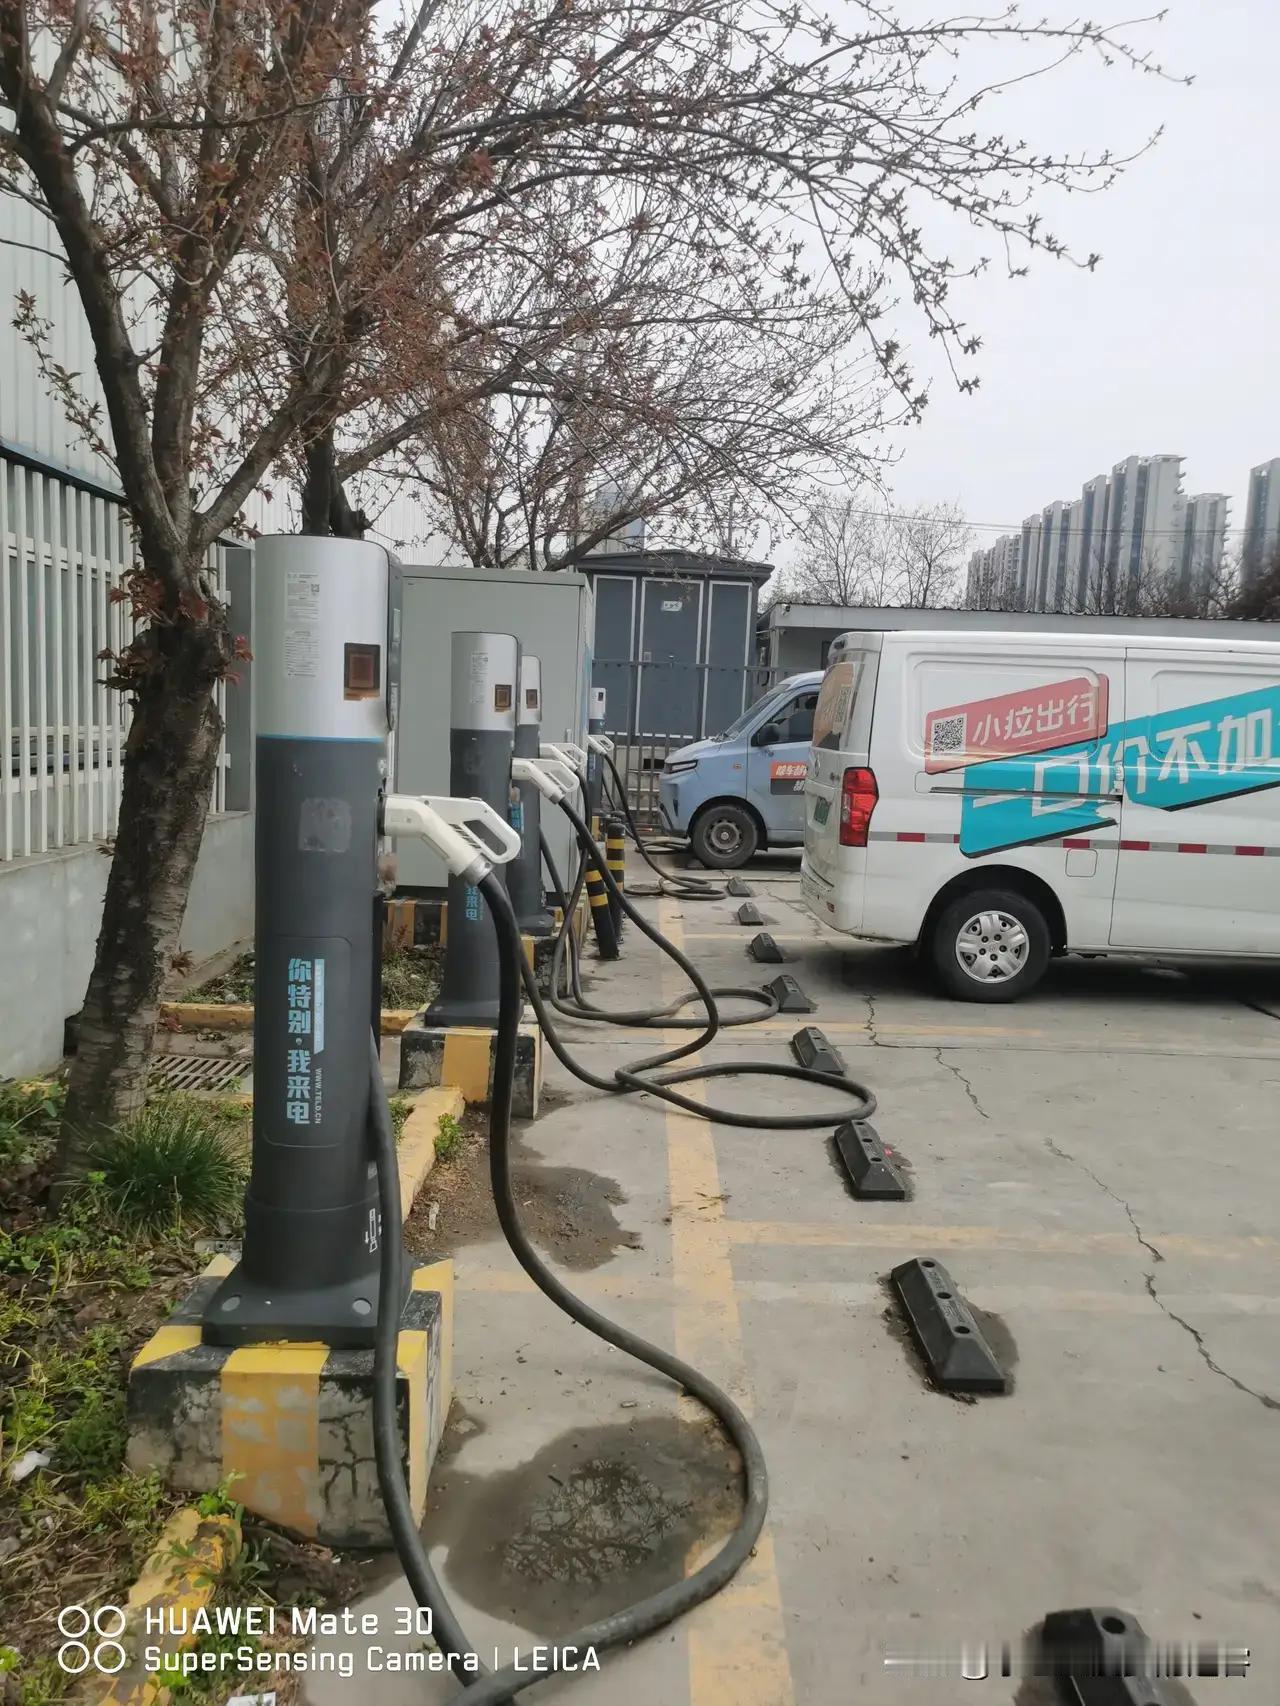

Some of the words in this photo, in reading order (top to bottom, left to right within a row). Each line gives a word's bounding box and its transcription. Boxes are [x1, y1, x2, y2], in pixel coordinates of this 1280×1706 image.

[972, 694, 1095, 746] 小拉出行
[972, 708, 1280, 817] 一口价不加
